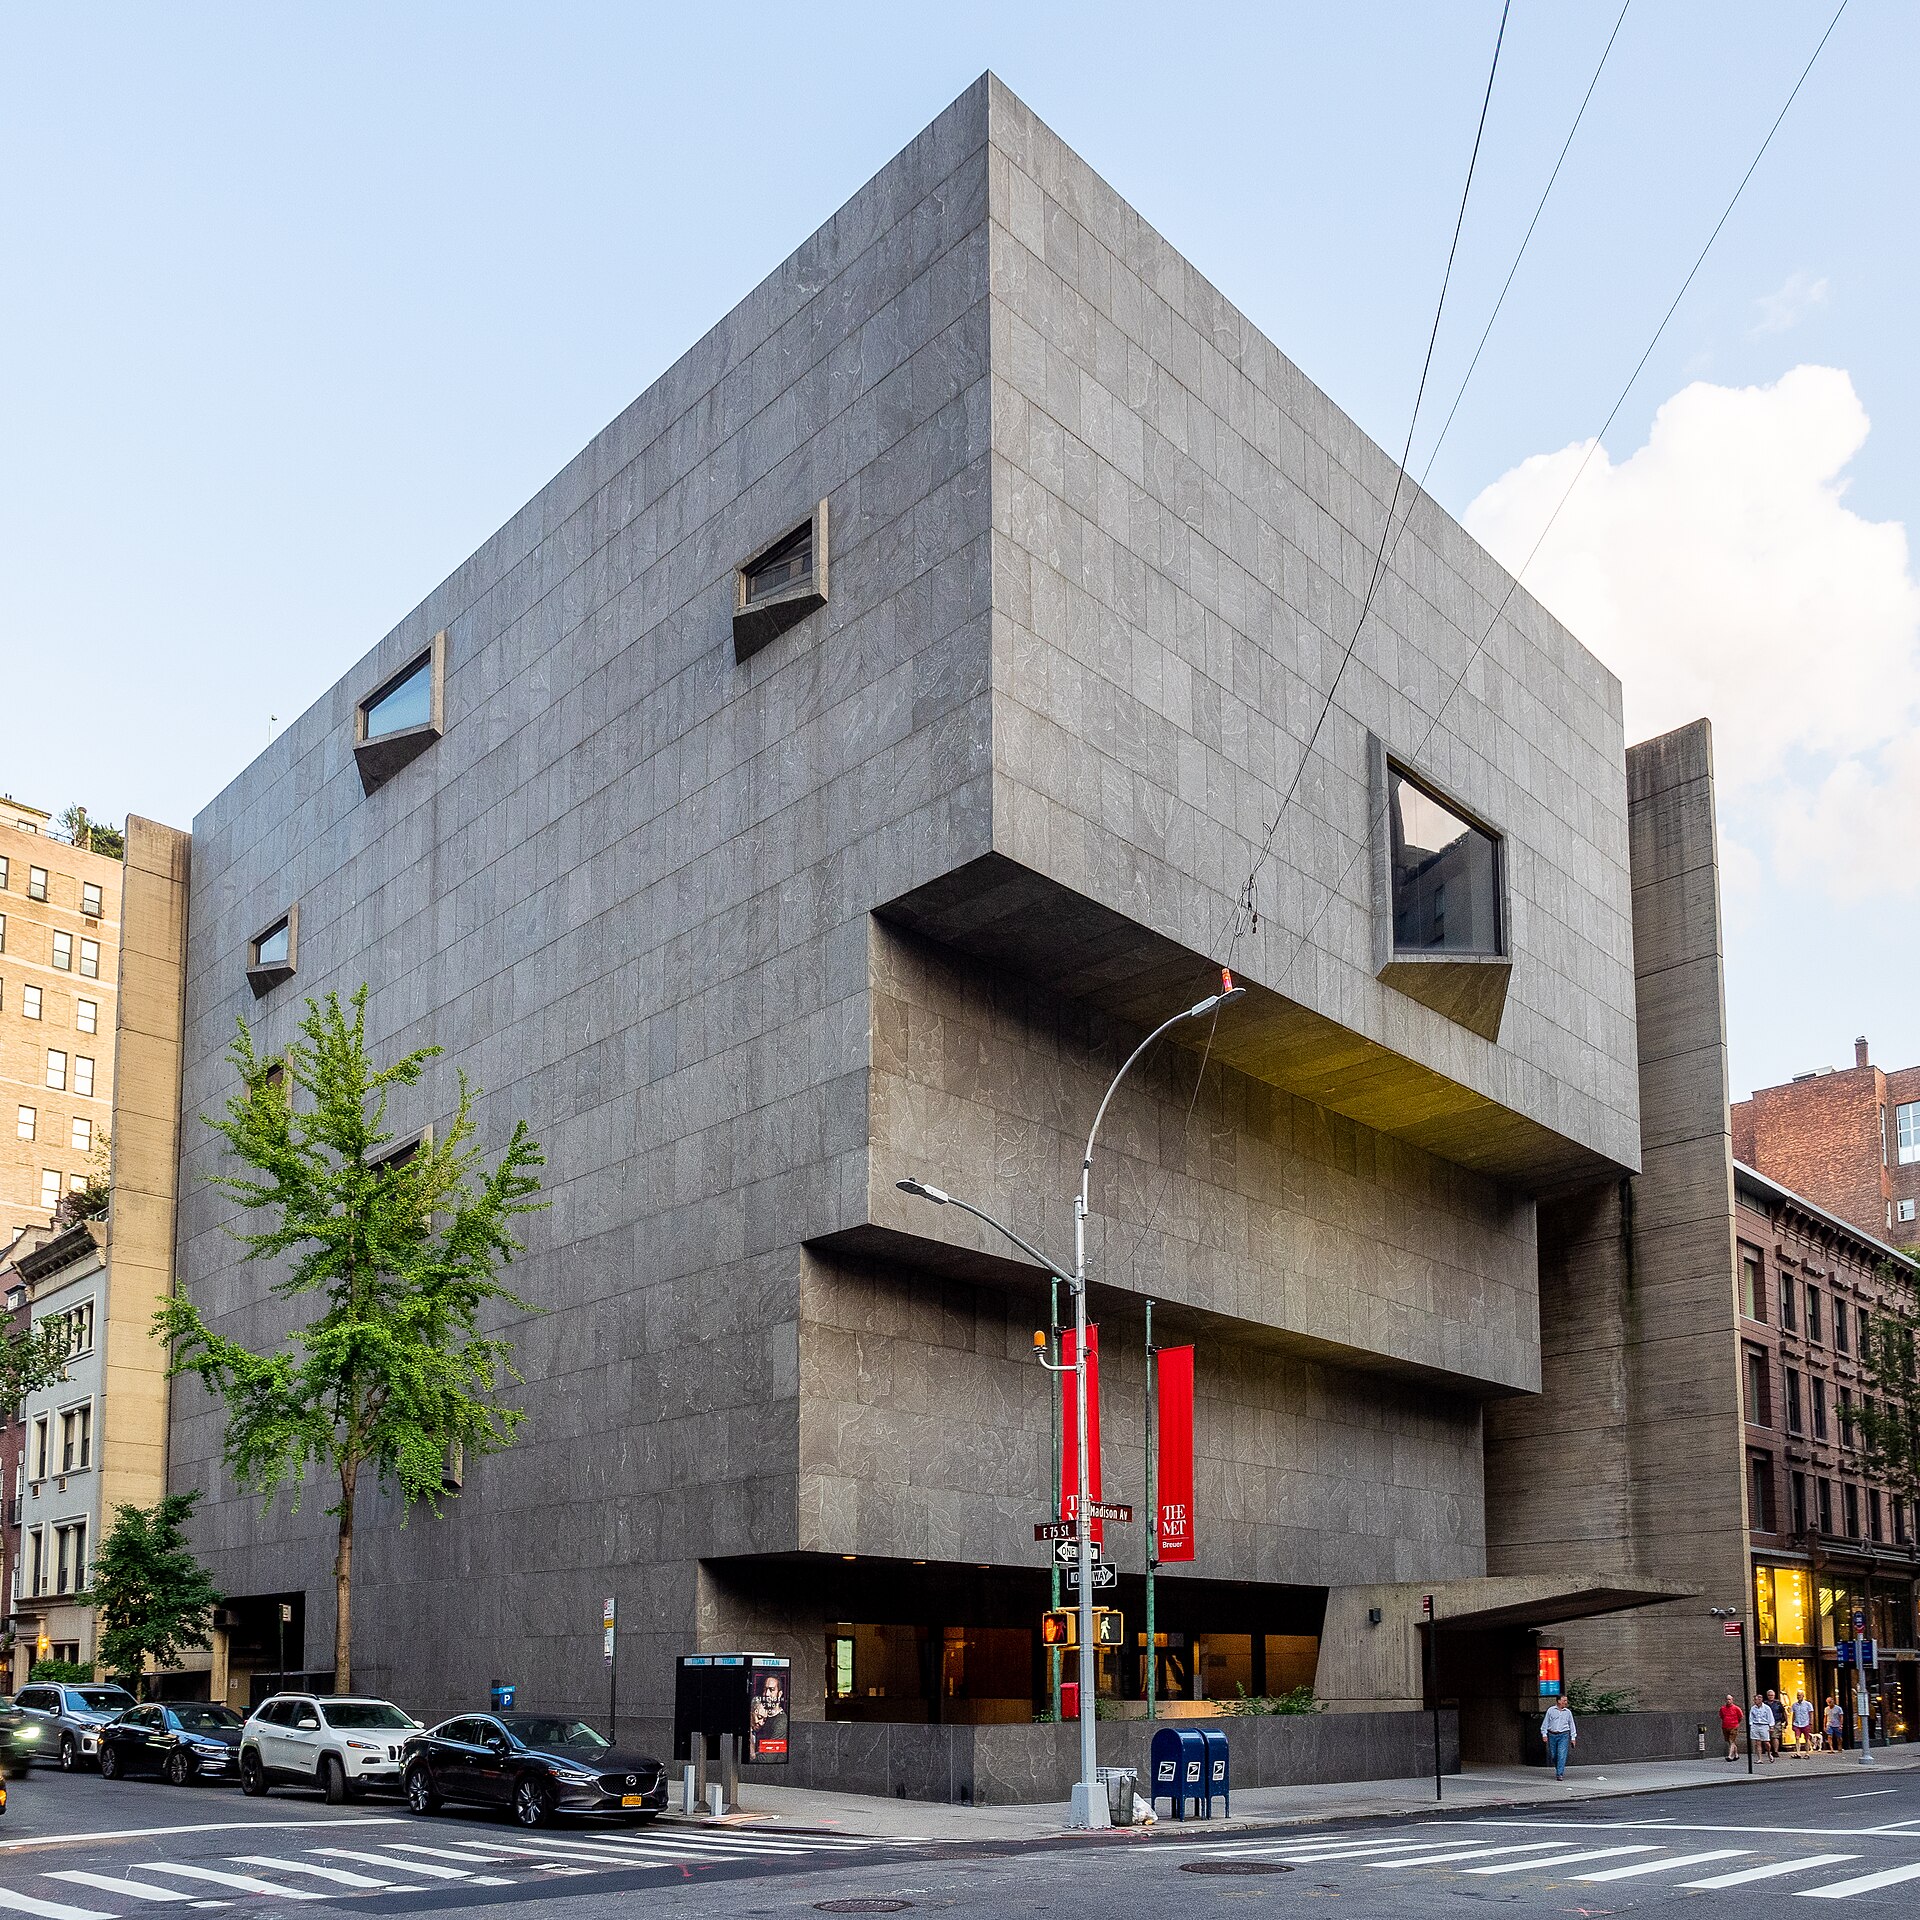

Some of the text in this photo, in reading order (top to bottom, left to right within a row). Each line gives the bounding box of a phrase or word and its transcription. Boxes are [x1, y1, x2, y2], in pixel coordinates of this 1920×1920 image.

[1090, 1505, 1128, 1521] Madison Av
[1162, 1504, 1186, 1520] THE
[1043, 1524, 1069, 1539] E 75 St
[1162, 1520, 1187, 1536] MET
[1061, 1546, 1076, 1556] ONE
[1162, 1541, 1183, 1549] Breuer
[1093, 1571, 1108, 1581] WAY
[504, 1695, 510, 1705] P
